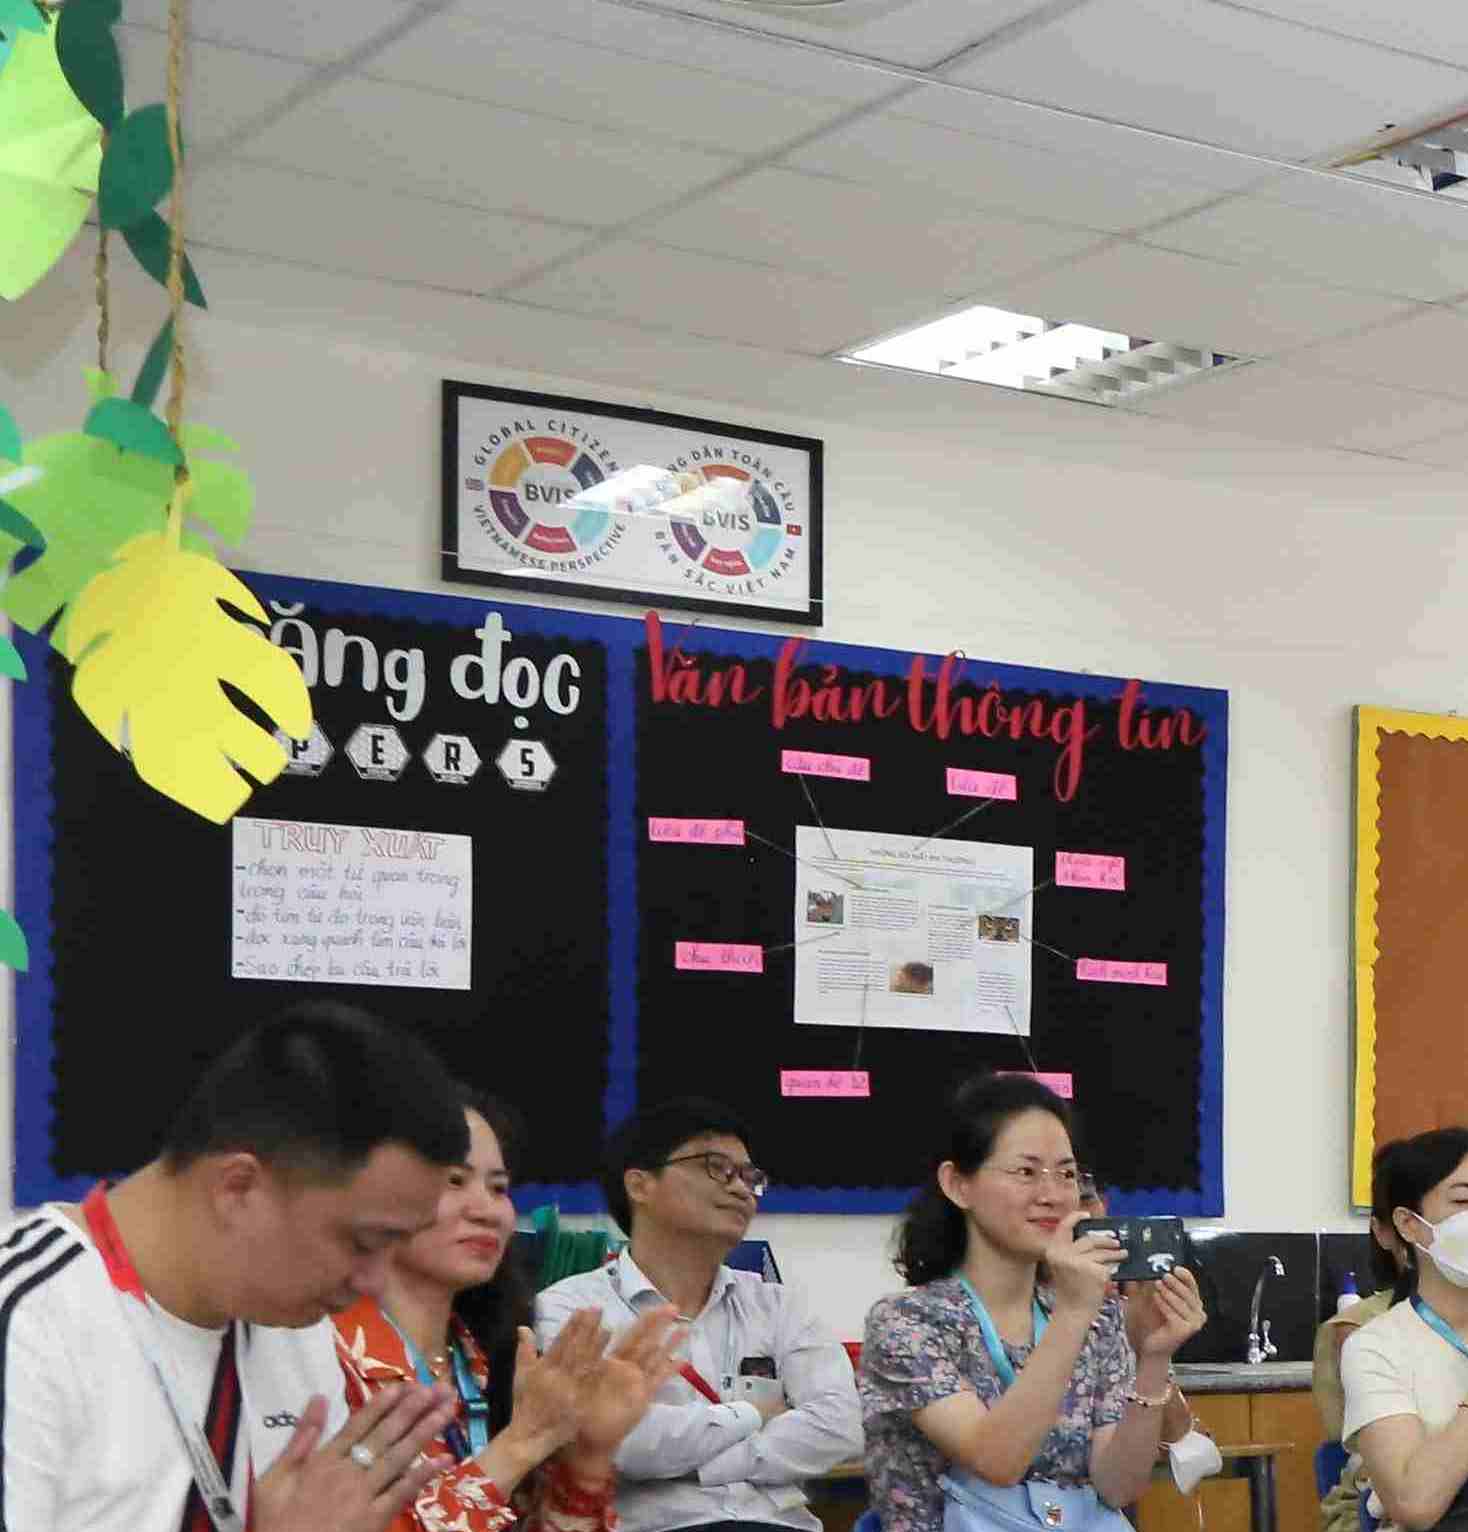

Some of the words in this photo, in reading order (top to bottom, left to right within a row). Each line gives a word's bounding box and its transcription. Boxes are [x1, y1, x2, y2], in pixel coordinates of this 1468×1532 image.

[474, 419, 536, 466] GLOBAL
[547, 418, 621, 473] CITIZEN
[525, 482, 576, 504] BVIS
[702, 510, 752, 533] BVIS
[250, 599, 427, 723] ăng
[449, 611, 583, 731] đọc
[905, 652, 1100, 802] thông
[1112, 678, 1209, 751] tin
[253, 820, 352, 855] TRUY
